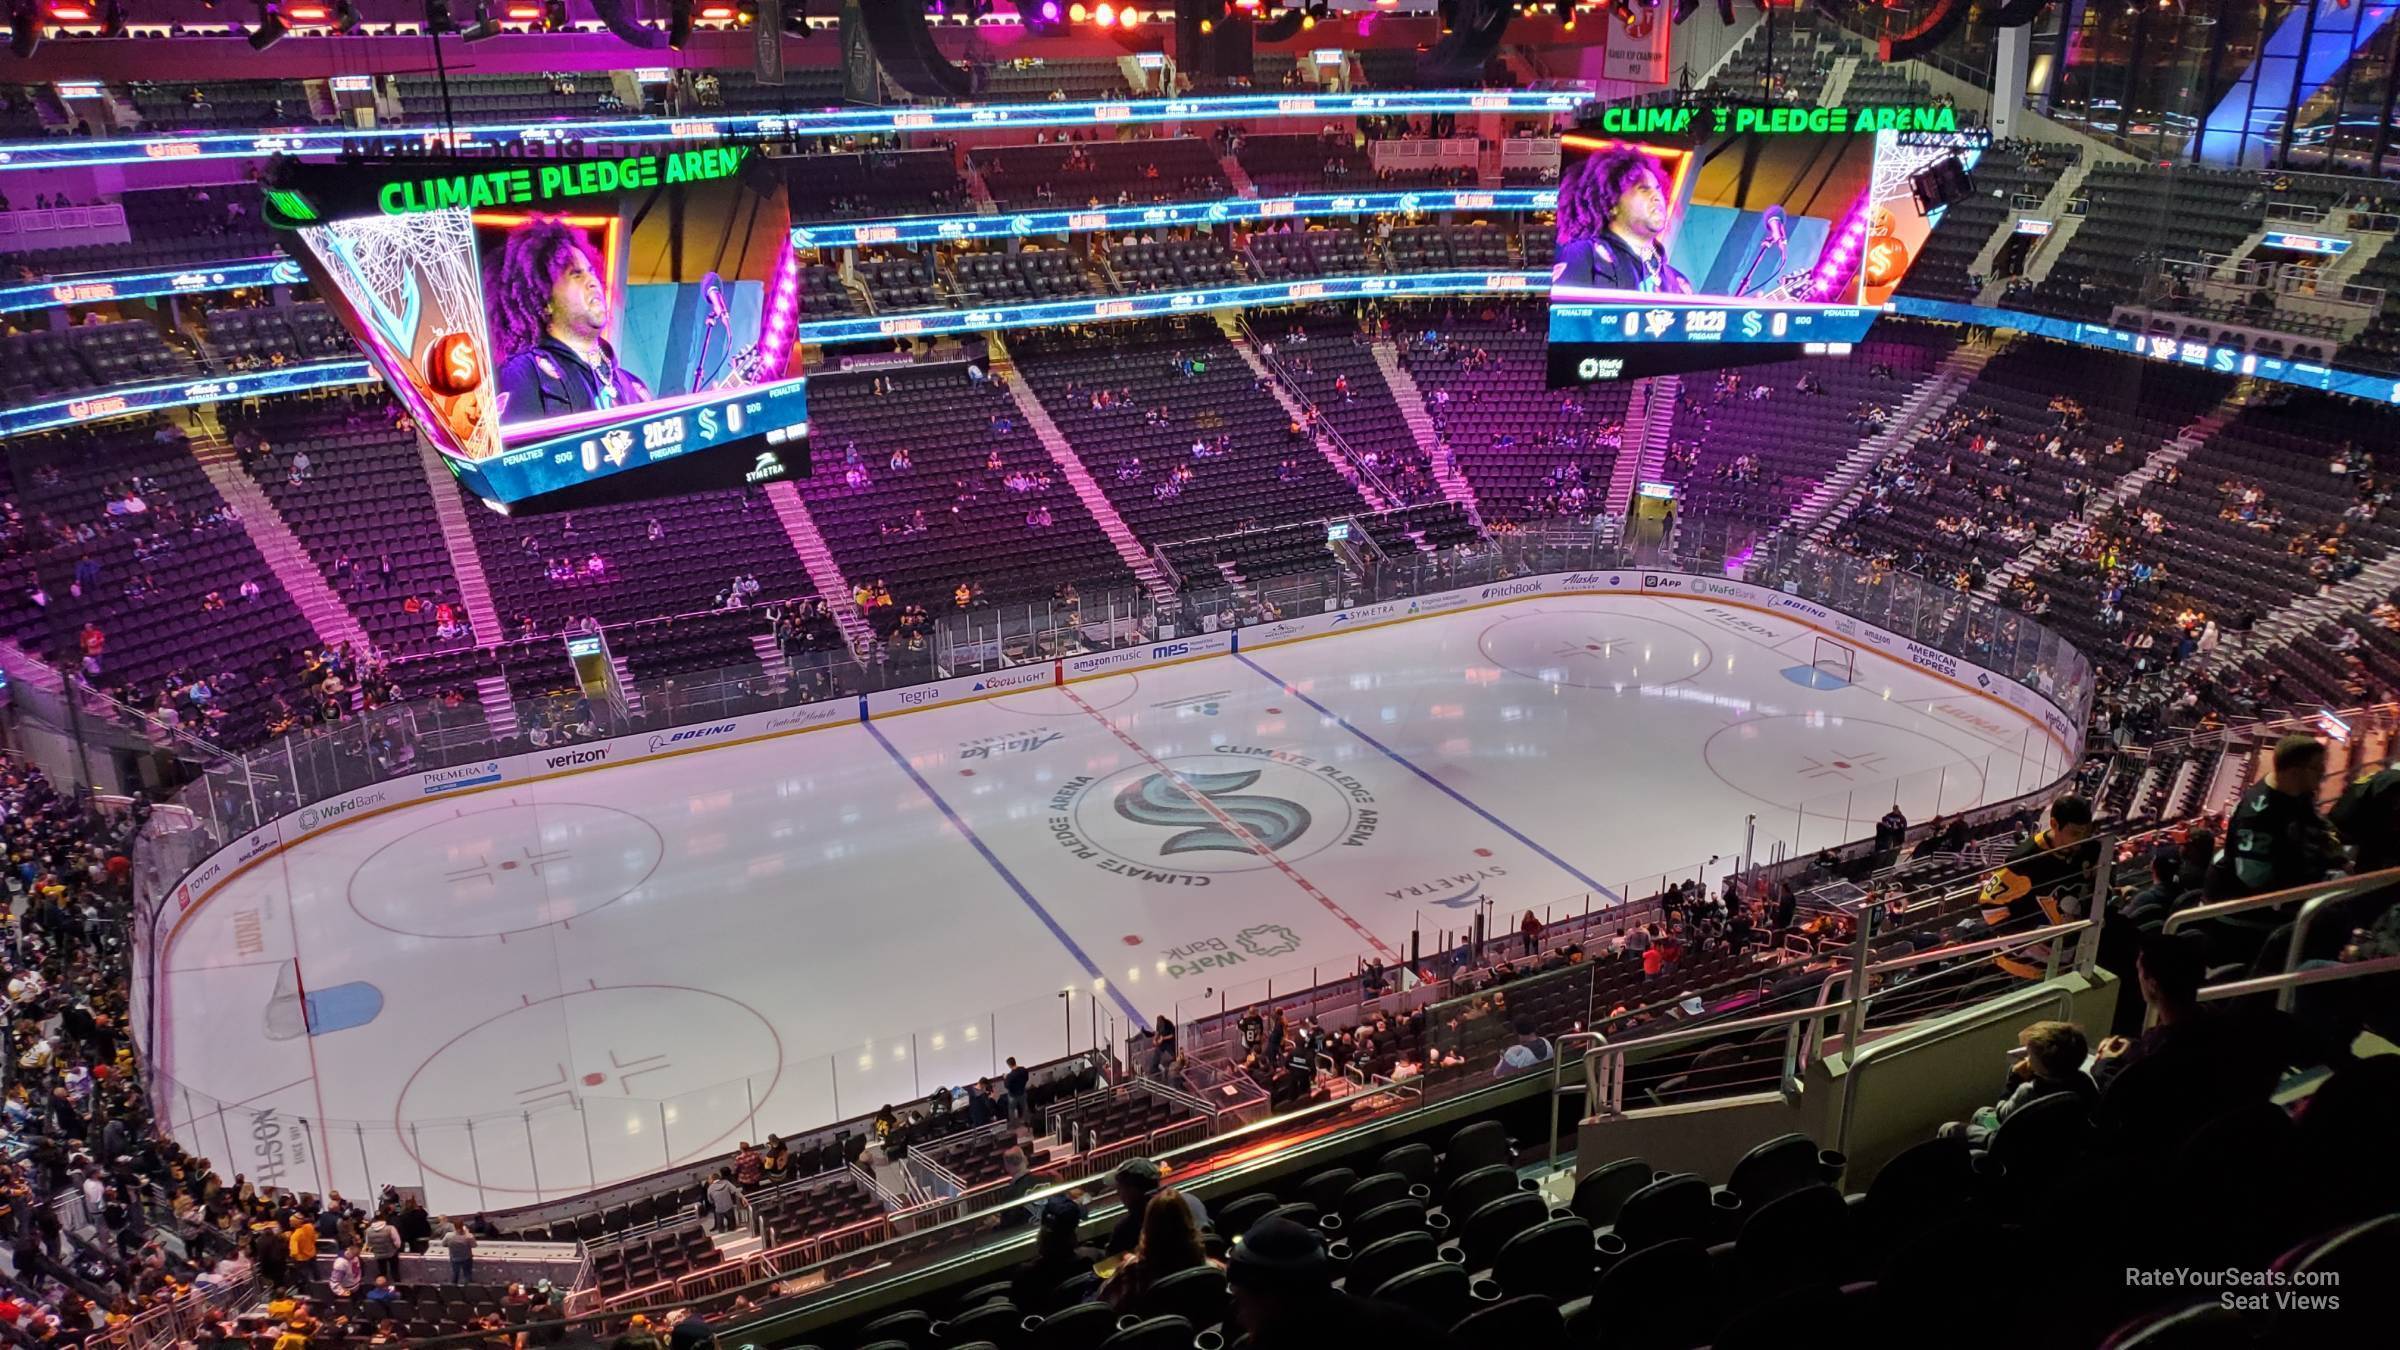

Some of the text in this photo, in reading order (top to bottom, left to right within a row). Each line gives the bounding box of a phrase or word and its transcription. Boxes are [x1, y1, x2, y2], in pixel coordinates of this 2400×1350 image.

[1604, 108, 1955, 134] CLIMAE PLEDGE ARENA
[380, 170, 531, 215] CLIMATE
[540, 157, 657, 199] PLEDGE
[1557, 308, 1593, 318] PENALTIES
[1685, 310, 1727, 332] 20:23
[1823, 309, 1860, 318] PENALTIES
[1625, 311, 1639, 336] 0
[1773, 312, 1788, 336] 0
[1599, 368, 1619, 379] Bank
[769, 383, 801, 399] PENALTIES
[726, 404, 742, 433] 0
[746, 402, 762, 415] SOG
[643, 416, 684, 450] 20:23
[503, 448, 544, 467] PENALTIES
[555, 451, 573, 464] SOG
[581, 440, 597, 472] 0
[649, 444, 683, 461] PREGAME
[745, 462, 784, 483] SYMETRA
[1562, 574, 1600, 585] Alaska
[1490, 580, 1542, 600] PitchBook
[1350, 605, 1394, 619] SYMETRA
[1783, 600, 1827, 618] BOEING
[1704, 608, 1780, 639] FILSON
[1864, 630, 1890, 645] amazon
[1153, 642, 1189, 659] MPS
[1906, 643, 1957, 668] AMERICAN
[1073, 651, 1142, 671] amazon music
[1912, 655, 1957, 677] EXPRESS
[986, 672, 1045, 690] Coors LIGHT
[899, 686, 939, 704] Tegria
[671, 723, 736, 743] BOEING
[546, 748, 606, 769] verizon
[424, 766, 481, 785] PREMERA
[1214, 745, 1378, 847] CLIMATE PLEDGE ARENA
[1048, 775, 1211, 887] CLIMATE PLEDGE ARENA
[190, 863, 221, 893] TOYOTA
[1385, 865, 1507, 901] SYMETRA
[1160, 936, 1230, 959] Bank
[1166, 949, 1247, 981] WaFd
